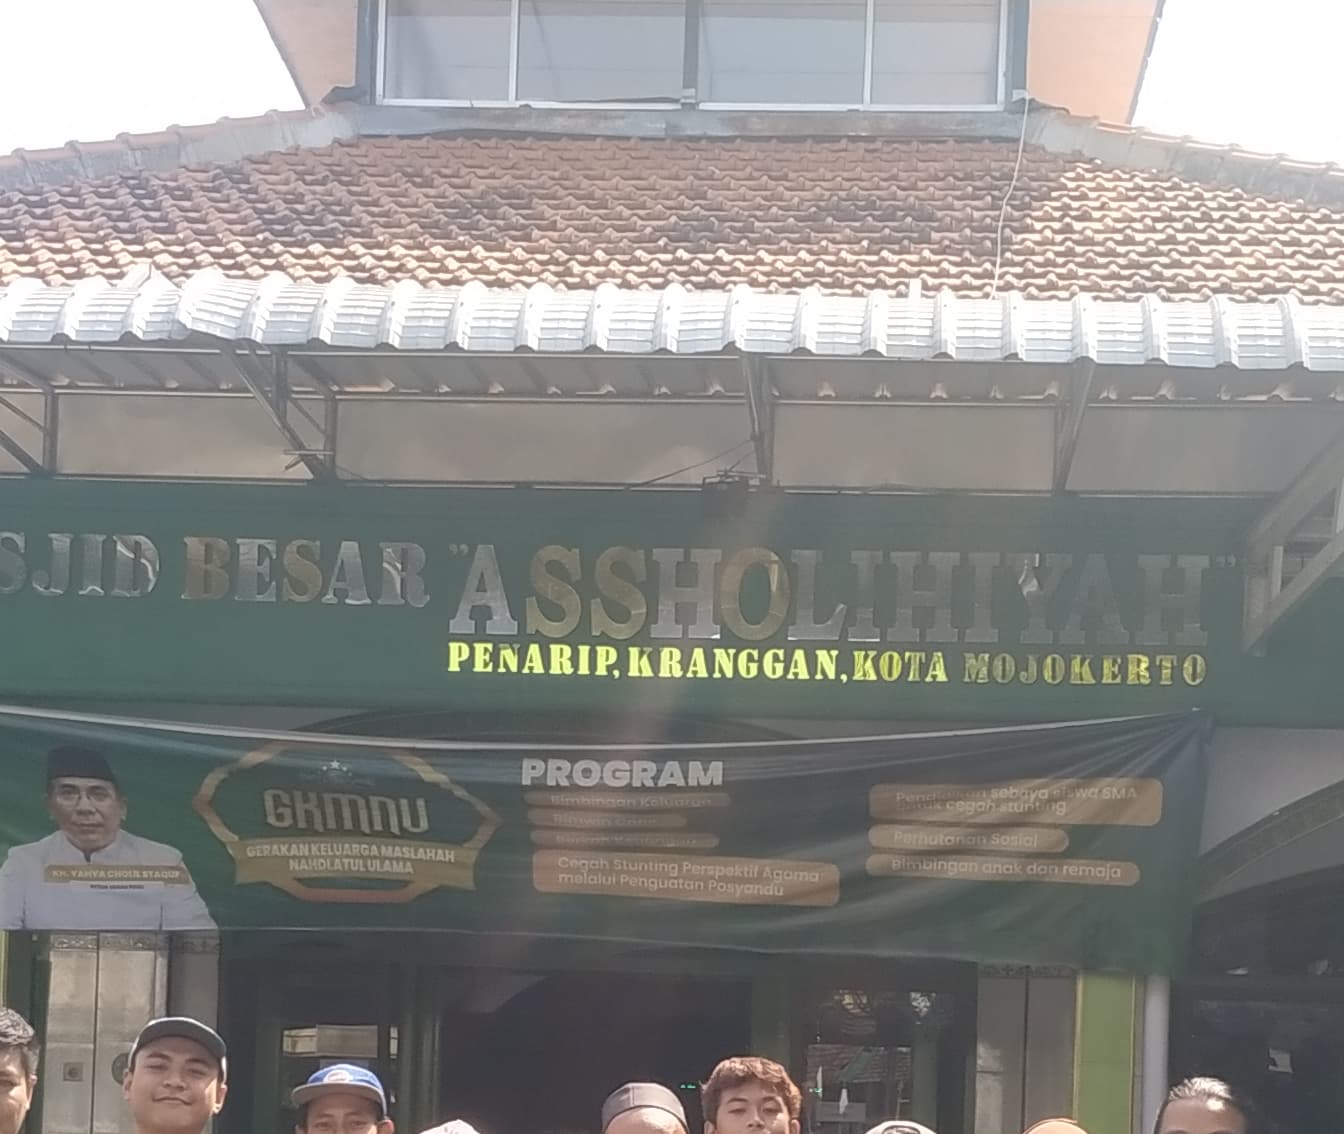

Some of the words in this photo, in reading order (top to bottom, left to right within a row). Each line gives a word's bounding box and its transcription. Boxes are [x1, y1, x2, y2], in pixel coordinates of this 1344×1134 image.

[180, 535, 431, 608] BESAR
[853, 650, 949, 683] KOTA
[963, 652, 1207, 687] MOJOKERTO
[521, 757, 724, 787] PROGRAM
[246, 842, 309, 858] GERAKAN
[309, 843, 380, 858] KELUARGA
[382, 847, 456, 864] MASLAHAH
[289, 858, 367, 873] NAHDLATUL
[368, 859, 414, 875] ULAMA
[557, 856, 609, 873] Cegah
[614, 858, 678, 877] Stunting
[682, 861, 758, 880] Perspektif
[763, 866, 820, 883] Agama
[891, 858, 978, 876] Bimbingan
[1062, 864, 1121, 881] remaja
[557, 871, 617, 886] melalui
[620, 875, 704, 891] Penguatan
[708, 879, 784, 897] Posyandu
